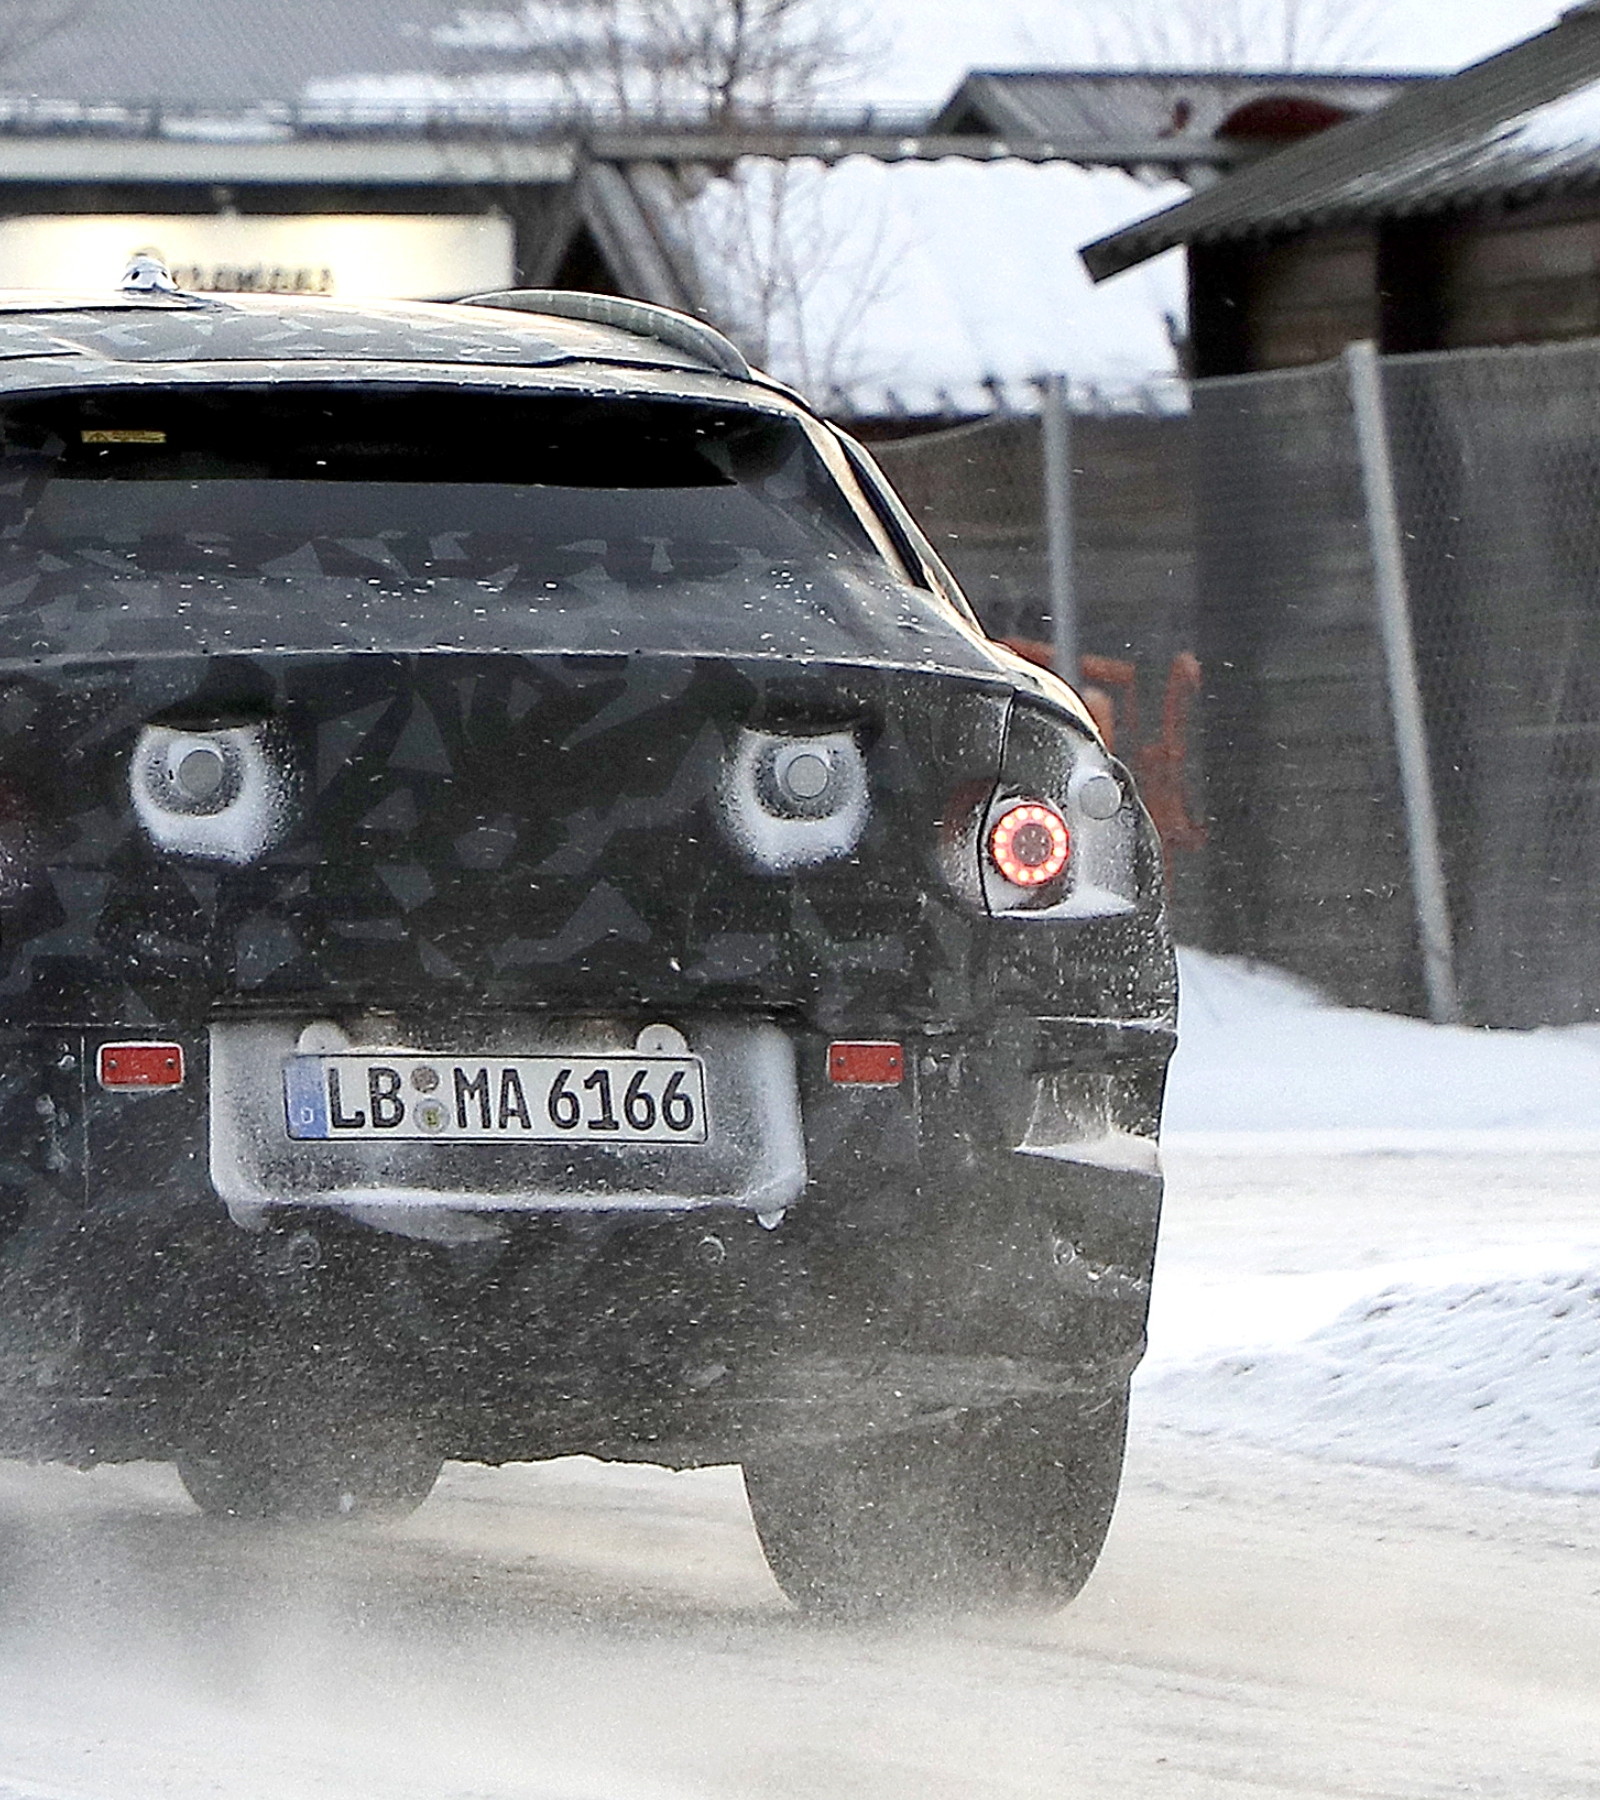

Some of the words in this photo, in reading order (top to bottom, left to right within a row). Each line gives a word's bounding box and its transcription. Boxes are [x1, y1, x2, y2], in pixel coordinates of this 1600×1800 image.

[328, 1067, 405, 1129] LB
[453, 1067, 532, 1129] MA
[549, 1069, 695, 1131] 6166
